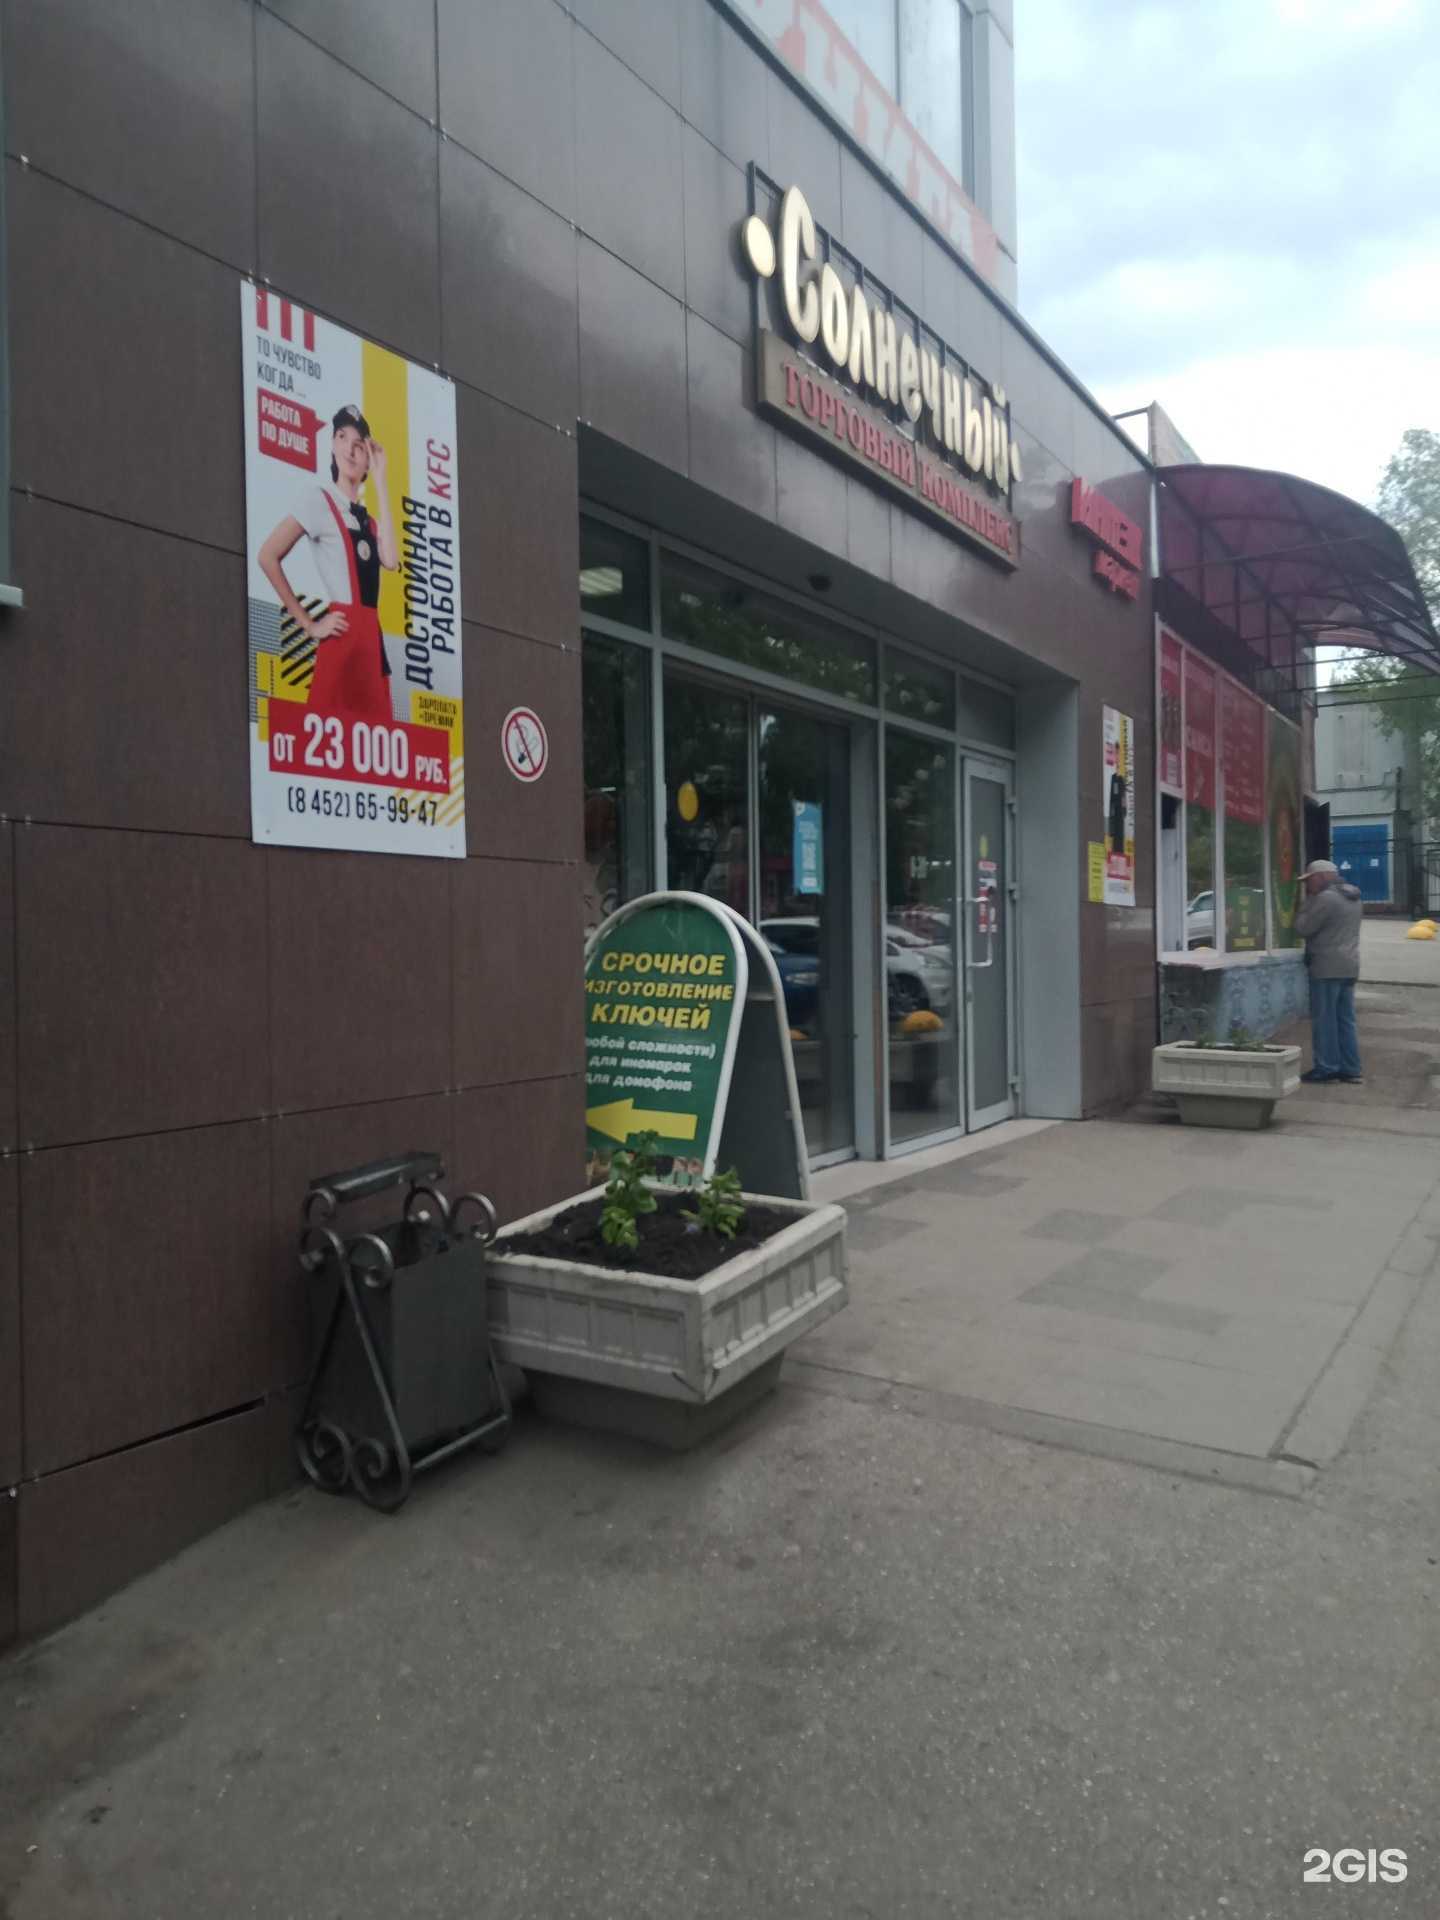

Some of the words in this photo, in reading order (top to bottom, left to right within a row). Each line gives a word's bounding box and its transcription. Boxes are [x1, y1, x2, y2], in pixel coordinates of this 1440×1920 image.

[779, 184, 1010, 496] Солнечный
[256, 336, 271, 357] ТО
[273, 343, 322, 380] ЧУВСТВО
[261, 396, 302, 429] РАБОТА
[783, 362, 916, 489] ТОРГОВЫЙ
[261, 420, 277, 442] ПО
[278, 428, 310, 455] ДУШЕ
[426, 438, 452, 500] KFC
[428, 504, 452, 529] В
[398, 496, 433, 690] ДОСТОЙНАЯ
[429, 537, 455, 654] РАБОТА
[272, 732, 295, 763] ОТ
[303, 713, 345, 770] 23
[352, 722, 409, 780] 000
[414, 755, 448, 785] РУБ.
[355, 792, 438, 827] 65-99-47
[601, 952, 727, 977] СРОЧНОЕ
[592, 1002, 712, 1030] КЛЮЧЕЙ
[589, 1055, 618, 1069] для
[620, 1058, 692, 1075] иномарок
[627, 1040, 716, 1059] сложности)
[613, 1074, 693, 1092] домофона
